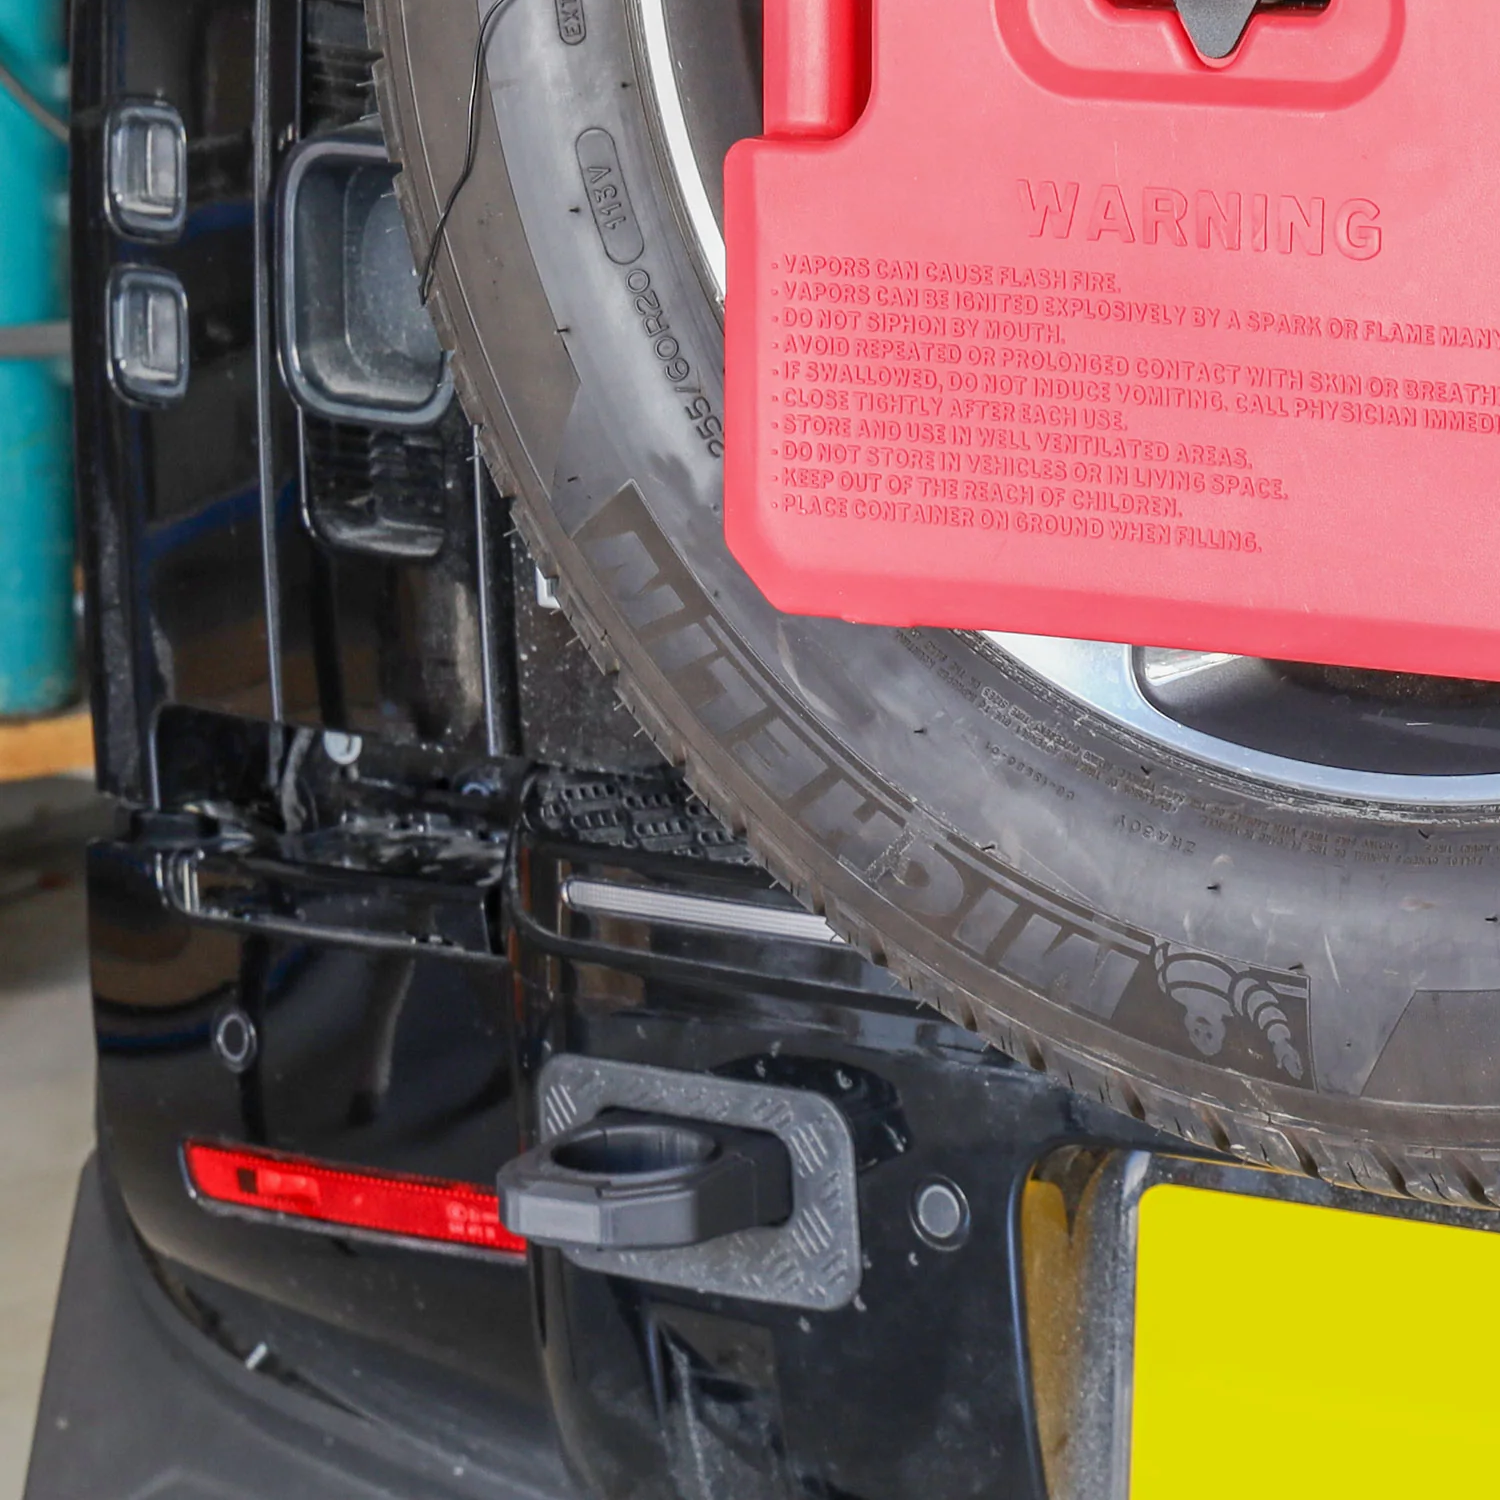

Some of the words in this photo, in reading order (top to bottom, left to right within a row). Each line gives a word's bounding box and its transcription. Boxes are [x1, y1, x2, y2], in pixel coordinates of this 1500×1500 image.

[587, 164, 627, 231] 113V
[1016, 178, 1384, 260] WARNING
[784, 255, 869, 277] VAPORS
[877, 260, 919, 281] CAN
[926, 262, 994, 285] CAUSE
[1000, 266, 1066, 289] FLASH
[1073, 271, 1121, 293] FIRE.
[783, 308, 812, 328] DO
[817, 310, 861, 330] NOT
[867, 312, 945, 336] SIPHON
[953, 317, 979, 337] BY
[984, 320, 1065, 344] MOUTH.
[784, 282, 869, 304] VAPORS
[877, 286, 919, 307] CAN
[925, 289, 949, 309] BE
[956, 291, 1038, 315] IGNITED
[1044, 297, 1185, 325] EXPLOSIVELY
[1192, 307, 1220, 327] BY
[1227, 310, 1241, 330] A
[1247, 312, 1322, 337] SPARK
[1329, 318, 1357, 340] OR
[1363, 320, 1435, 345] FLAME
[783, 361, 800, 381] IF
[805, 362, 943, 393] SWALLOWED,
[949, 371, 978, 391] DO
[983, 374, 1027, 395] NOT
[1033, 377, 1111, 403] INDUCE
[1116, 383, 1228, 412] VOMITING.
[1235, 394, 1289, 417] CALL
[1295, 398, 1417, 428] PHYSICIAN
[784, 334, 849, 356] AVOID
[856, 339, 961, 364] REPEATED
[968, 345, 996, 367] OR
[1002, 349, 1129, 376] PROLONGED
[1136, 357, 1241, 385] CONTACT
[1246, 365, 1303, 389] WITH
[1309, 371, 1361, 396] SKIN
[1369, 376, 1399, 397] OR
[784, 388, 850, 410] CLOSE
[856, 391, 943, 417] TIGHTLY
[950, 399, 1015, 422] AFTER
[1020, 403, 1076, 426] EACH
[1084, 409, 1128, 431] USE.
[783, 414, 851, 436] STORE
[858, 419, 901, 441] AND
[906, 422, 945, 444] USE
[951, 425, 972, 446] IN
[977, 427, 1030, 450] WELL
[1037, 430, 1169, 462] VENTILATED
[1175, 444, 1253, 469] AREAS.
[783, 441, 812, 460] DO
[817, 443, 861, 464] NOT
[867, 446, 935, 470] STORE
[939, 451, 960, 472] IN
[967, 454, 1067, 480] VEHICLES
[1073, 462, 1102, 484] OR
[1108, 466, 1128, 486] IN
[1132, 468, 1206, 493] LIVING
[1211, 474, 1289, 500] SPACE.
[783, 467, 834, 489] KEEP
[840, 471, 882, 492] OUT
[888, 475, 913, 495] OF
[918, 477, 958, 499] THE
[963, 481, 1034, 506] REACH
[1040, 487, 1065, 507] OF
[1072, 489, 1183, 518] CHILDREN.
[783, 494, 848, 517] PLACE
[854, 500, 974, 529] CONTAINER
[980, 510, 1009, 531] ON
[1016, 512, 1104, 539] GROUND
[1109, 519, 1171, 544] WHEN
[1176, 526, 1262, 553] FILLING.
[587, 530, 1138, 1021] MICHELIN
